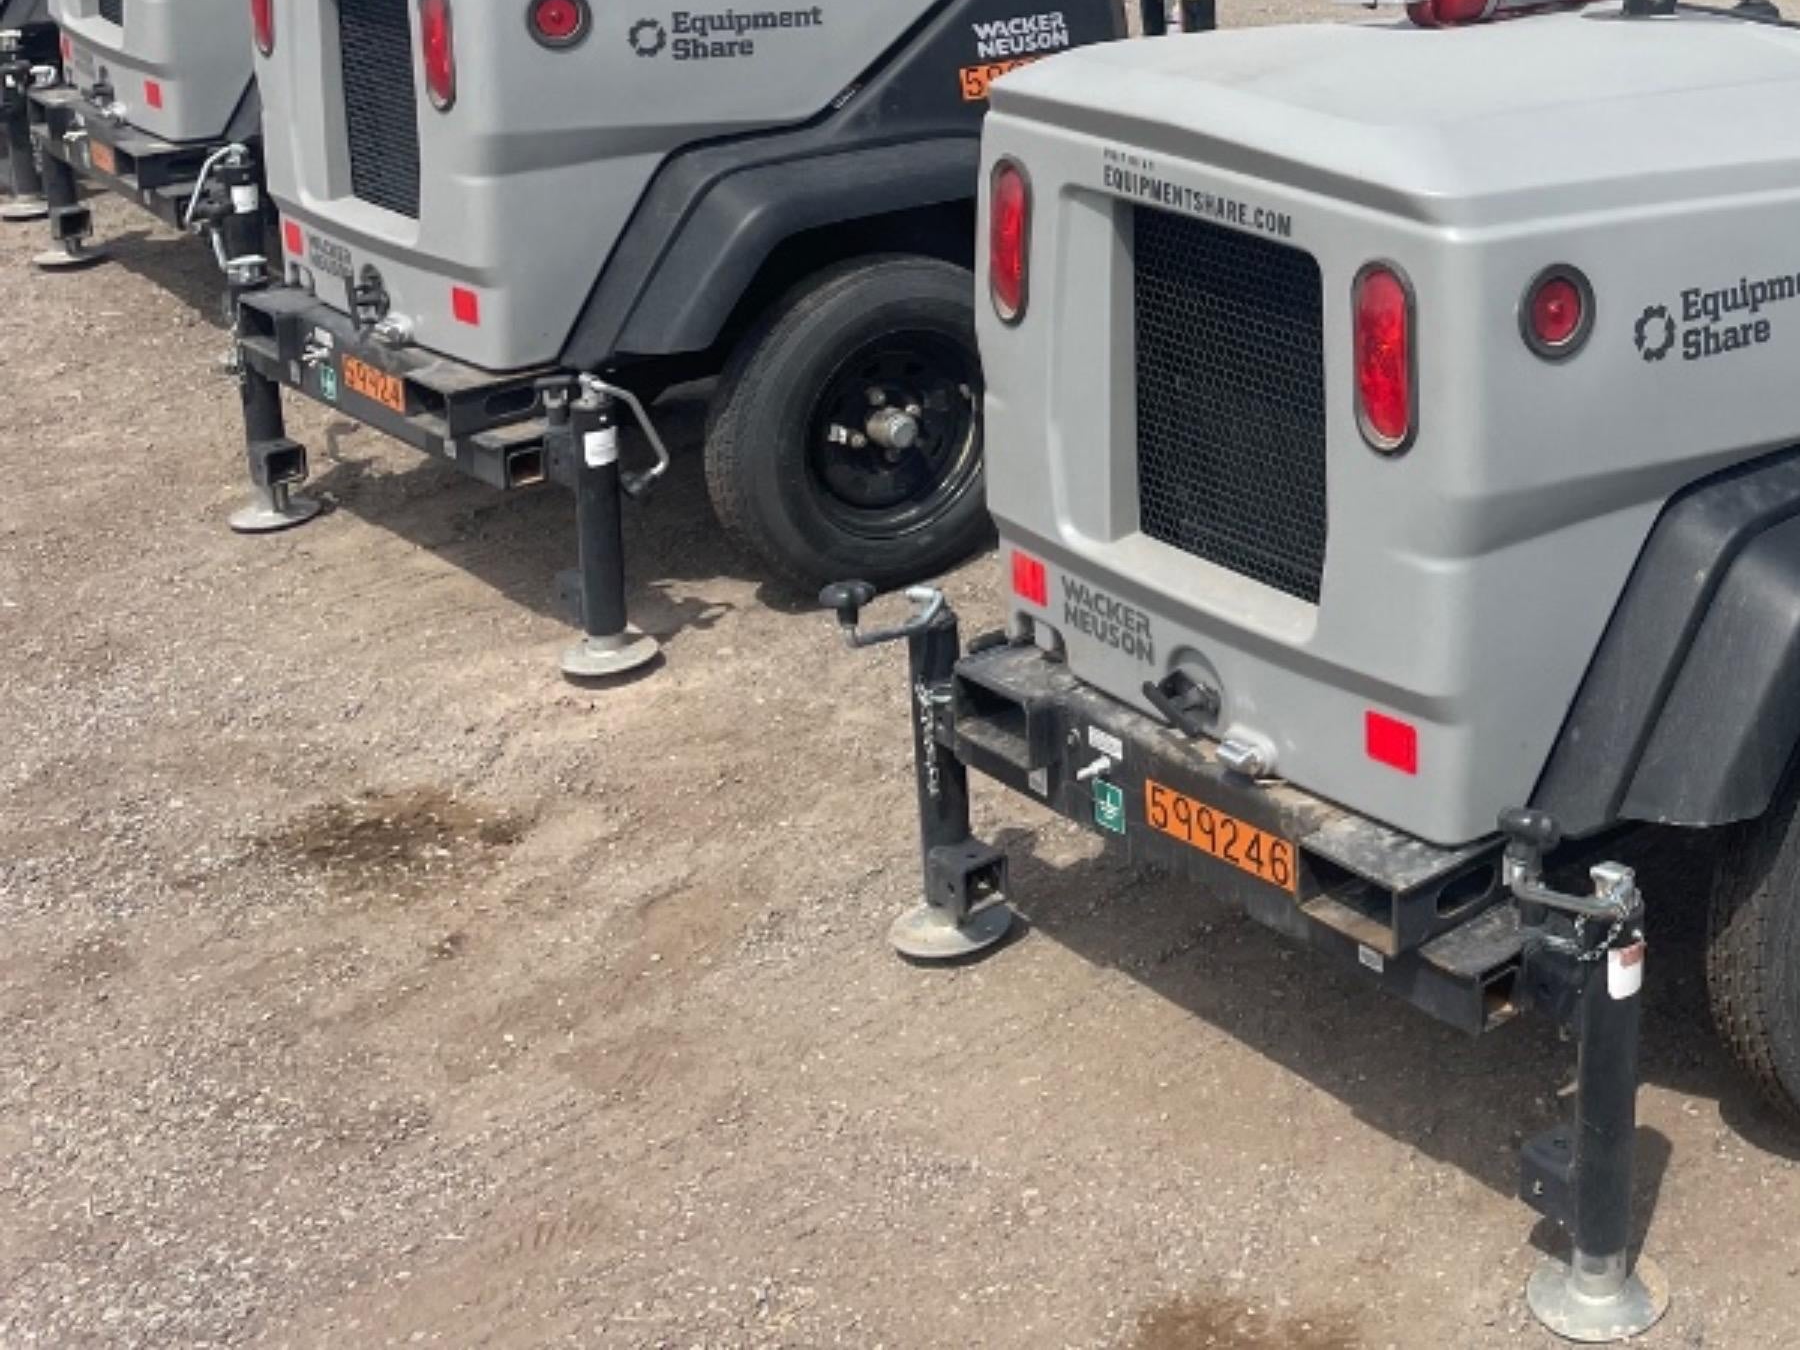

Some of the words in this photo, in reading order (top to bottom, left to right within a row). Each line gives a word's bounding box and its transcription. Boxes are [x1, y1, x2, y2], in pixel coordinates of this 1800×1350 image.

[671, 6, 823, 37] Equipment
[972, 11, 1066, 40] WACKER
[671, 38, 754, 60] Share
[977, 29, 1069, 58] NEUSON
[1103, 164, 1292, 238] EQUIPMENTSHARE.COM
[1682, 318, 1771, 360] Share
[1061, 575, 1153, 640] WACKER
[1063, 601, 1156, 667] NEUSON
[1151, 784, 1289, 886] 599246
